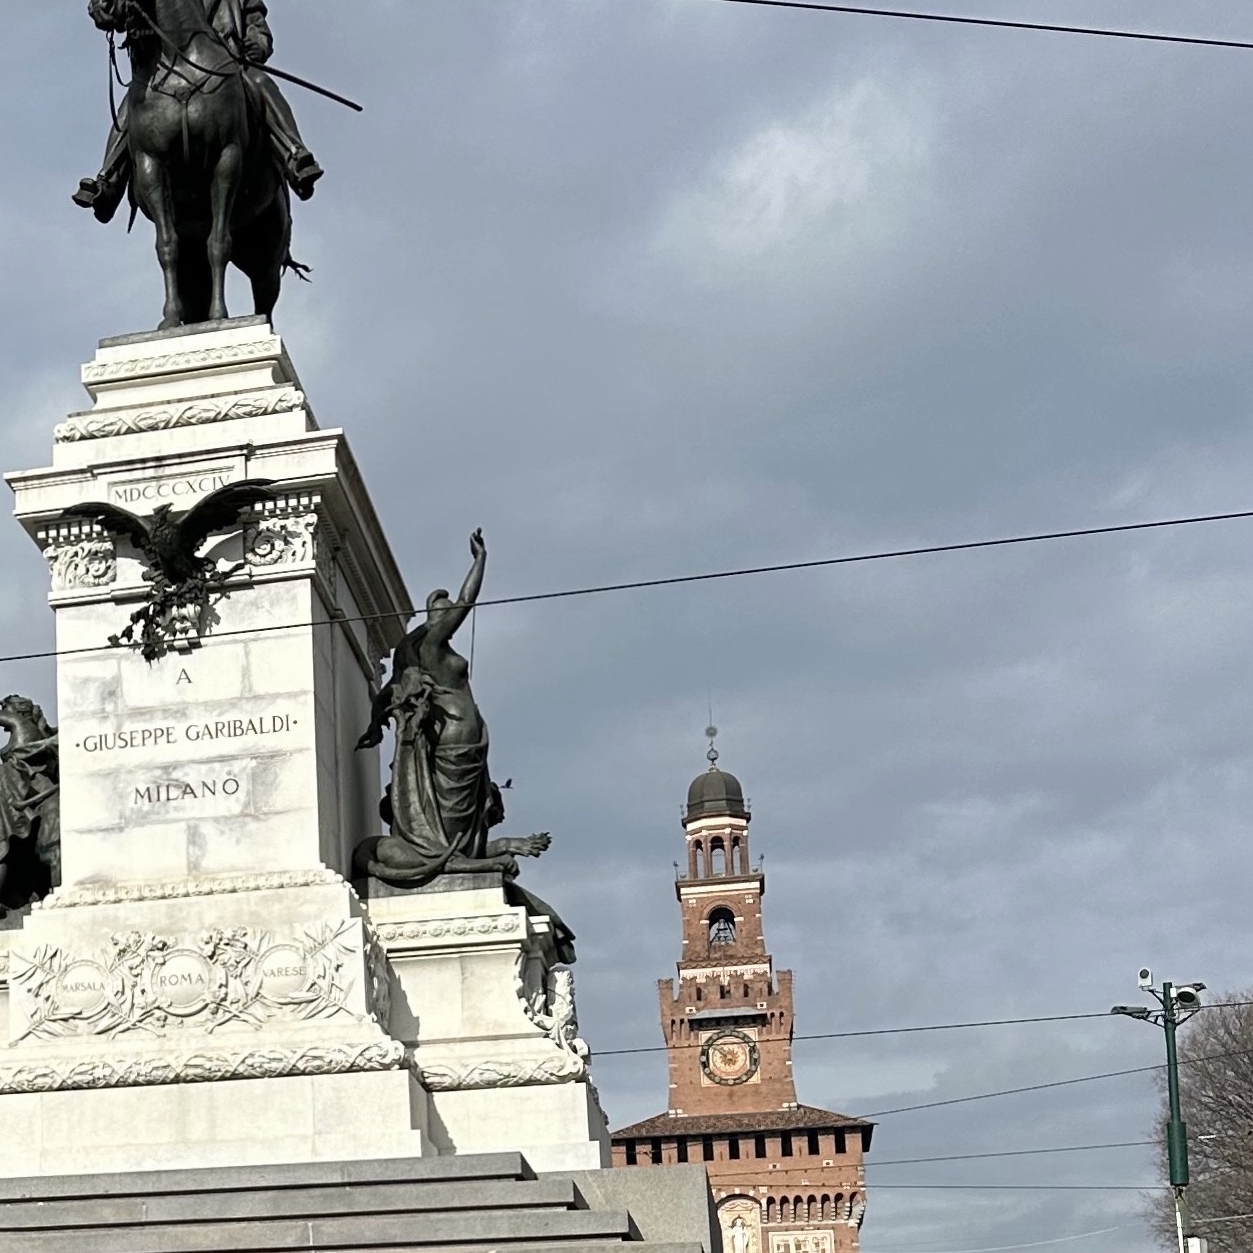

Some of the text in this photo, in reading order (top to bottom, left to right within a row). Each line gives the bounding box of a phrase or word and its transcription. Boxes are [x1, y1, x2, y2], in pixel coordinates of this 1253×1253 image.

[114, 475, 230, 503] MDCCCXCIV
[175, 668, 193, 685] A
[133, 777, 240, 805] MILANO
[262, 965, 307, 978] VARESE
[61, 981, 106, 994] MARSALA
[159, 973, 206, 987] ROMA
